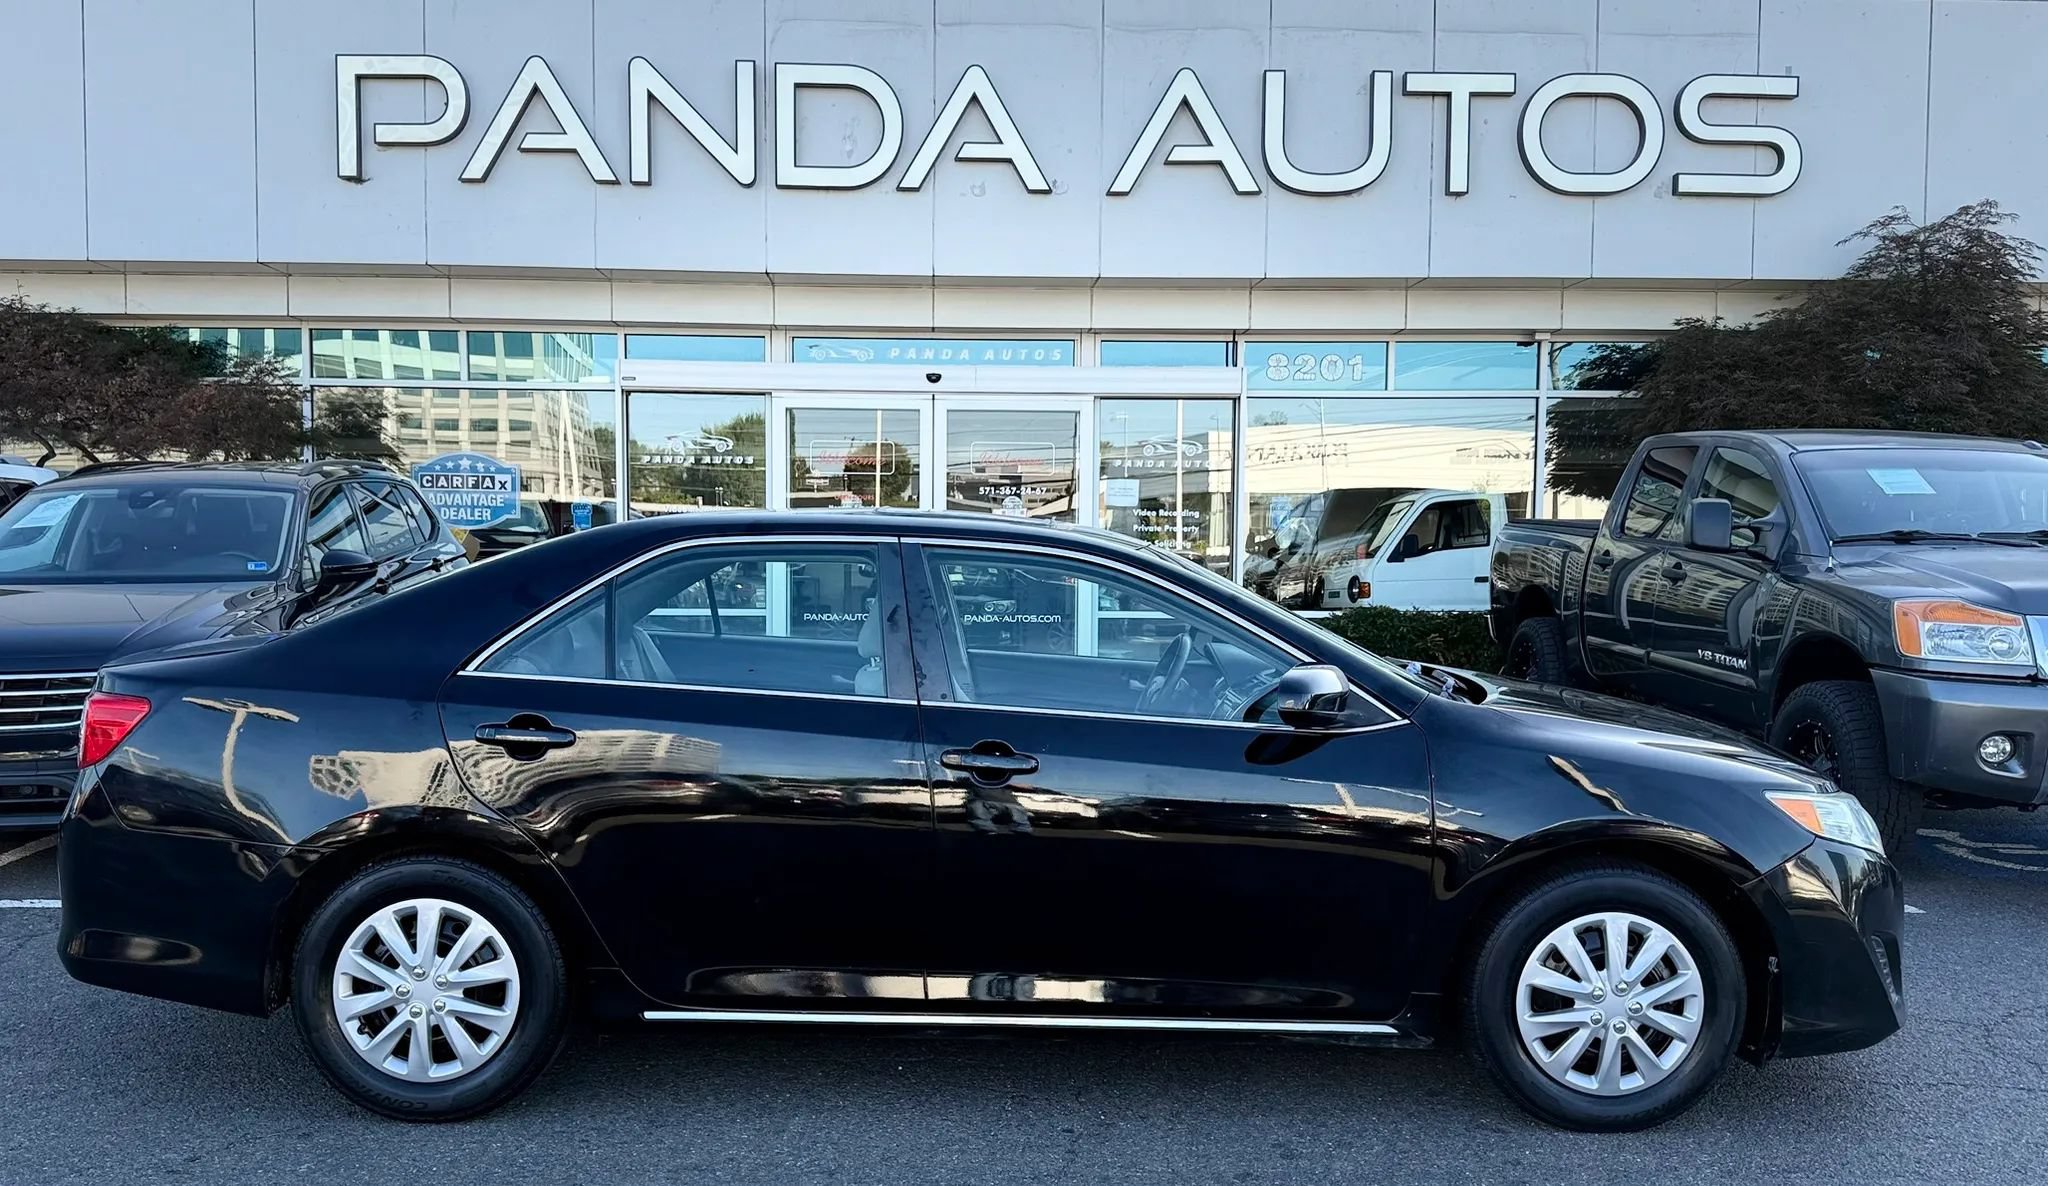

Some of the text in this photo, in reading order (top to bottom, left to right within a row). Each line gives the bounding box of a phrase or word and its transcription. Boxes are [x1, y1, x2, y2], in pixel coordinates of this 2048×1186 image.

[335, 53, 1803, 197] PANDA AUTOS
[889, 348, 1063, 361] PANDA AUTOS
[1266, 352, 1365, 382] 8201
[641, 455, 755, 465] PANDA AUTOS
[1114, 459, 1165, 468] PANDA
[421, 475, 508, 490] CARFAX
[978, 486, 1047, 495] 571-367-24-67
[428, 493, 505, 507] ADVANTAGE
[440, 507, 492, 520] DEALER
[1133, 509, 1200, 519] Video Recoding
[1133, 524, 1200, 535] Private Proerty
[1714, 653, 1748, 670] TITAN
